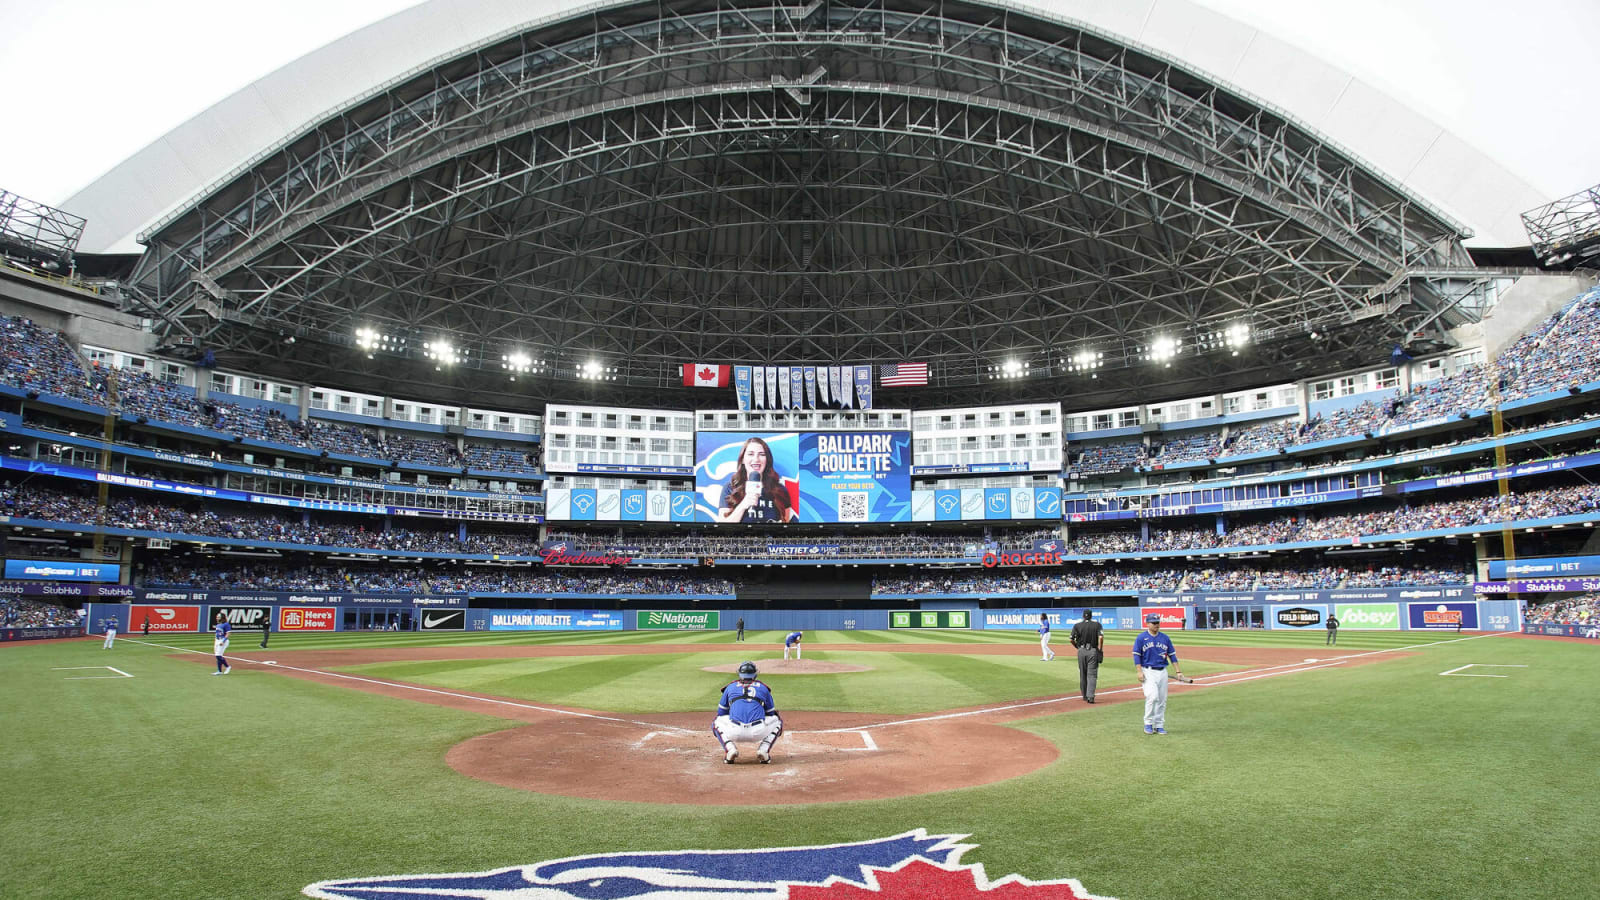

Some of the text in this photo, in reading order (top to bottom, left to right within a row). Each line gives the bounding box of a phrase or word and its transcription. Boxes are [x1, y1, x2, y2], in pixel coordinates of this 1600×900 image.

[818, 434, 892, 454] BALLPARK
[155, 453, 214, 467] CARLOS DELGADO
[819, 453, 891, 473] ROULETTE
[270, 470, 284, 479] TOM
[334, 479, 385, 491] TONY FERNANDEZ
[428, 488, 448, 496] CARTER
[768, 546, 810, 554] WESTJET
[540, 549, 633, 565] Budweiser
[1001, 552, 1063, 566] ROGERS
[1560, 562, 1580, 571] BET
[81, 569, 100, 577] BET
[43, 586, 81, 595] StubHub
[98, 587, 134, 597] StubHub
[1474, 584, 1510, 593] StubHub
[1526, 582, 1565, 592] StubHub
[145, 592, 208, 601] theScore BET
[1446, 589, 1462, 597] BET
[220, 608, 264, 624] MNP
[304, 610, 332, 620] Here's
[662, 612, 708, 624] National
[895, 614, 909, 625] TD
[923, 614, 936, 625] TD
[950, 614, 964, 625] TD
[986, 613, 1023, 625] BALLPARK
[1279, 613, 1319, 622] FIELD ROAST
[1487, 615, 1511, 624] 328
[304, 619, 327, 628] How.
[492, 615, 572, 626] BALLPARK ROULETTE
[1142, 641, 1169, 653] BLUE JAYS
